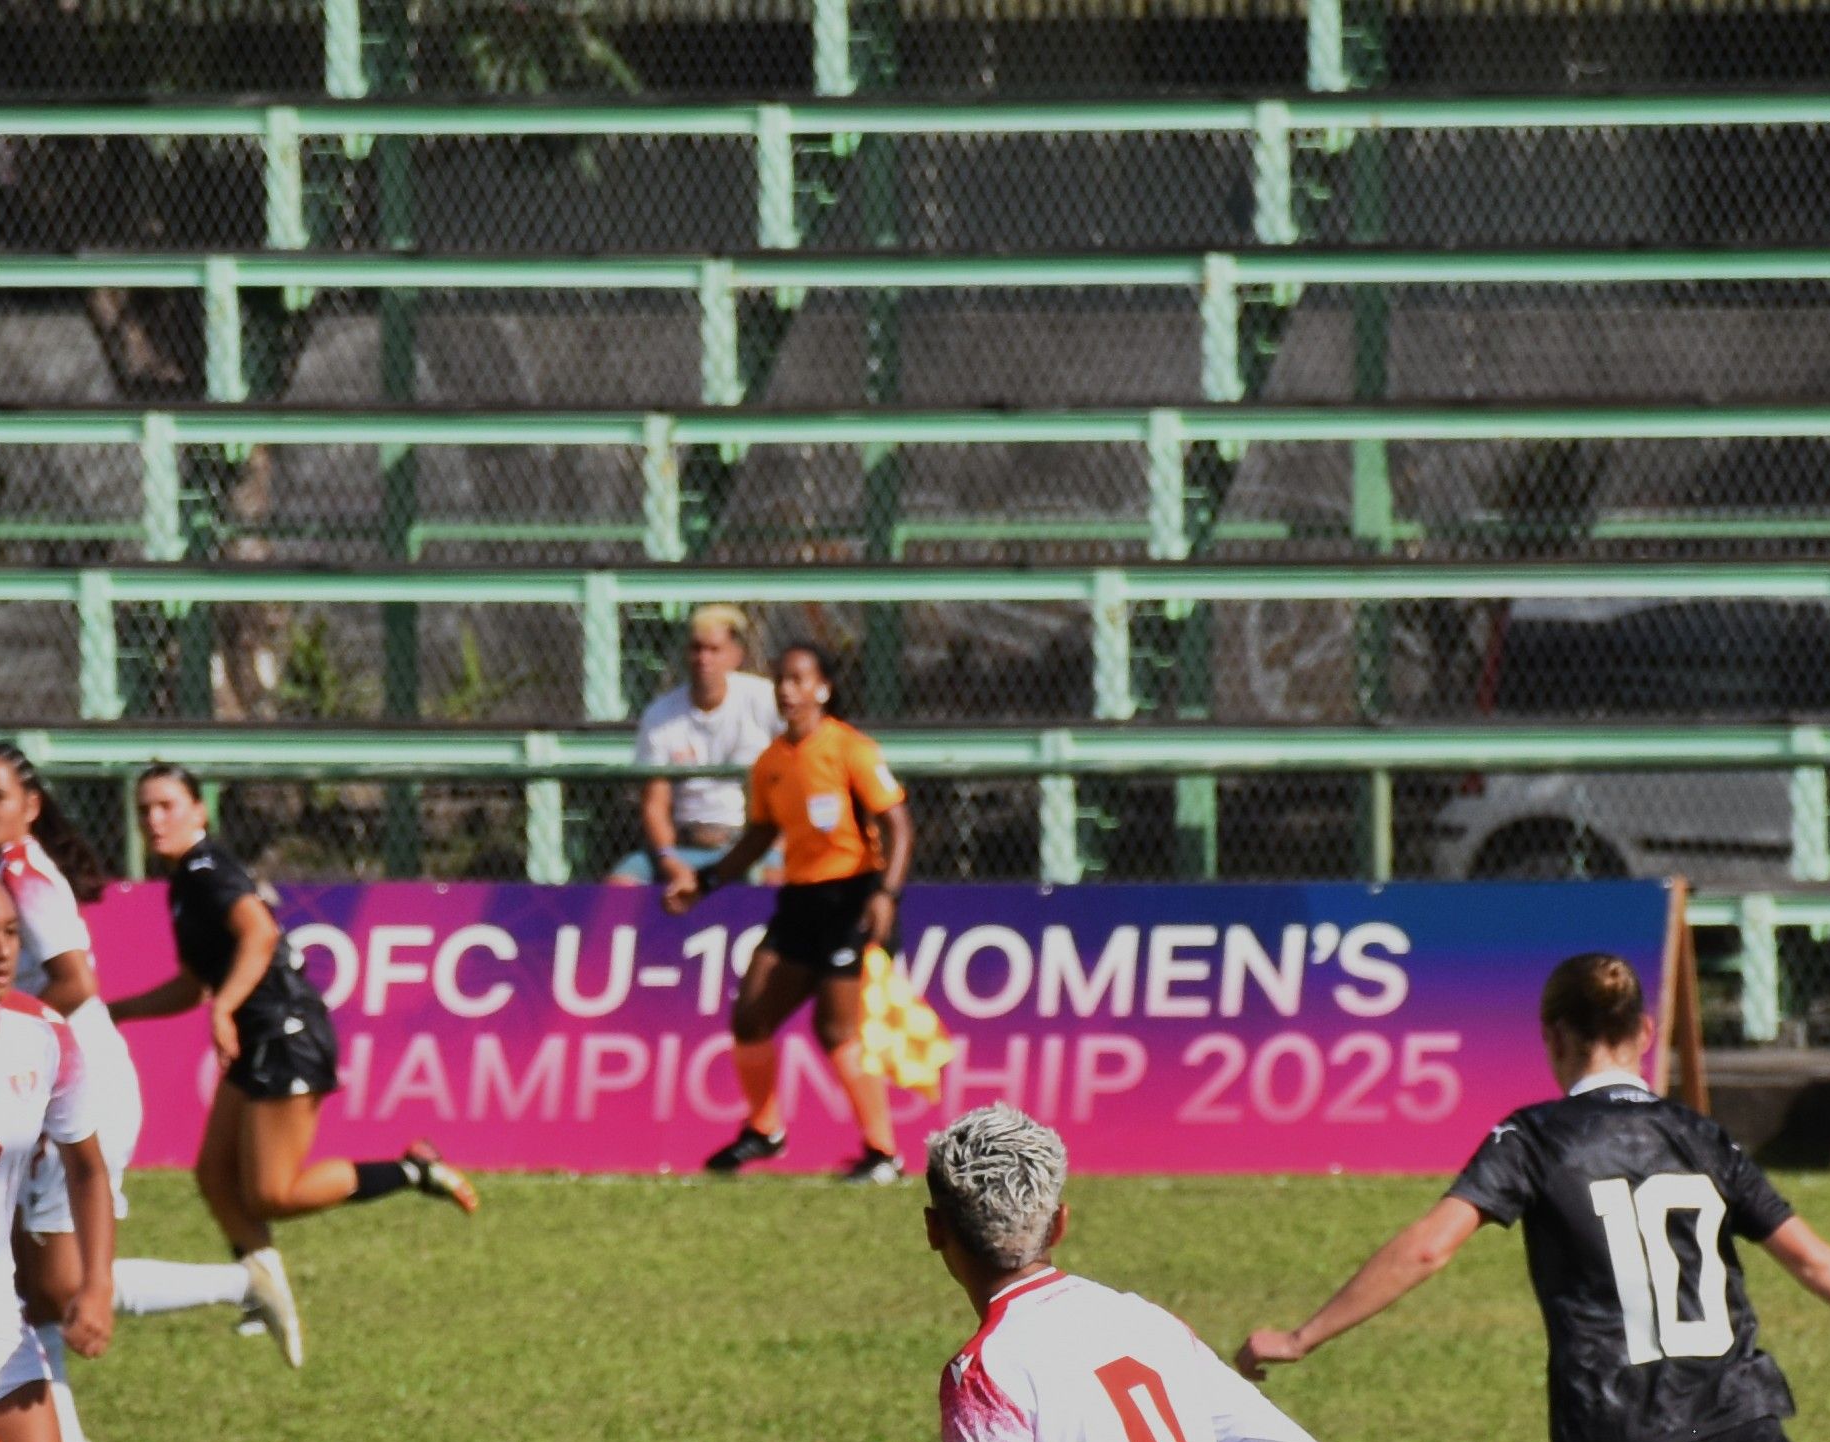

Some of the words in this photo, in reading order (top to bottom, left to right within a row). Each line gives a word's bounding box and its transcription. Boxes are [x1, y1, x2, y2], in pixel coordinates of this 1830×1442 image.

[287, 923, 518, 1018] OFC
[1176, 1031, 1463, 1125] 2025
[1589, 1173, 1735, 1366] 10
